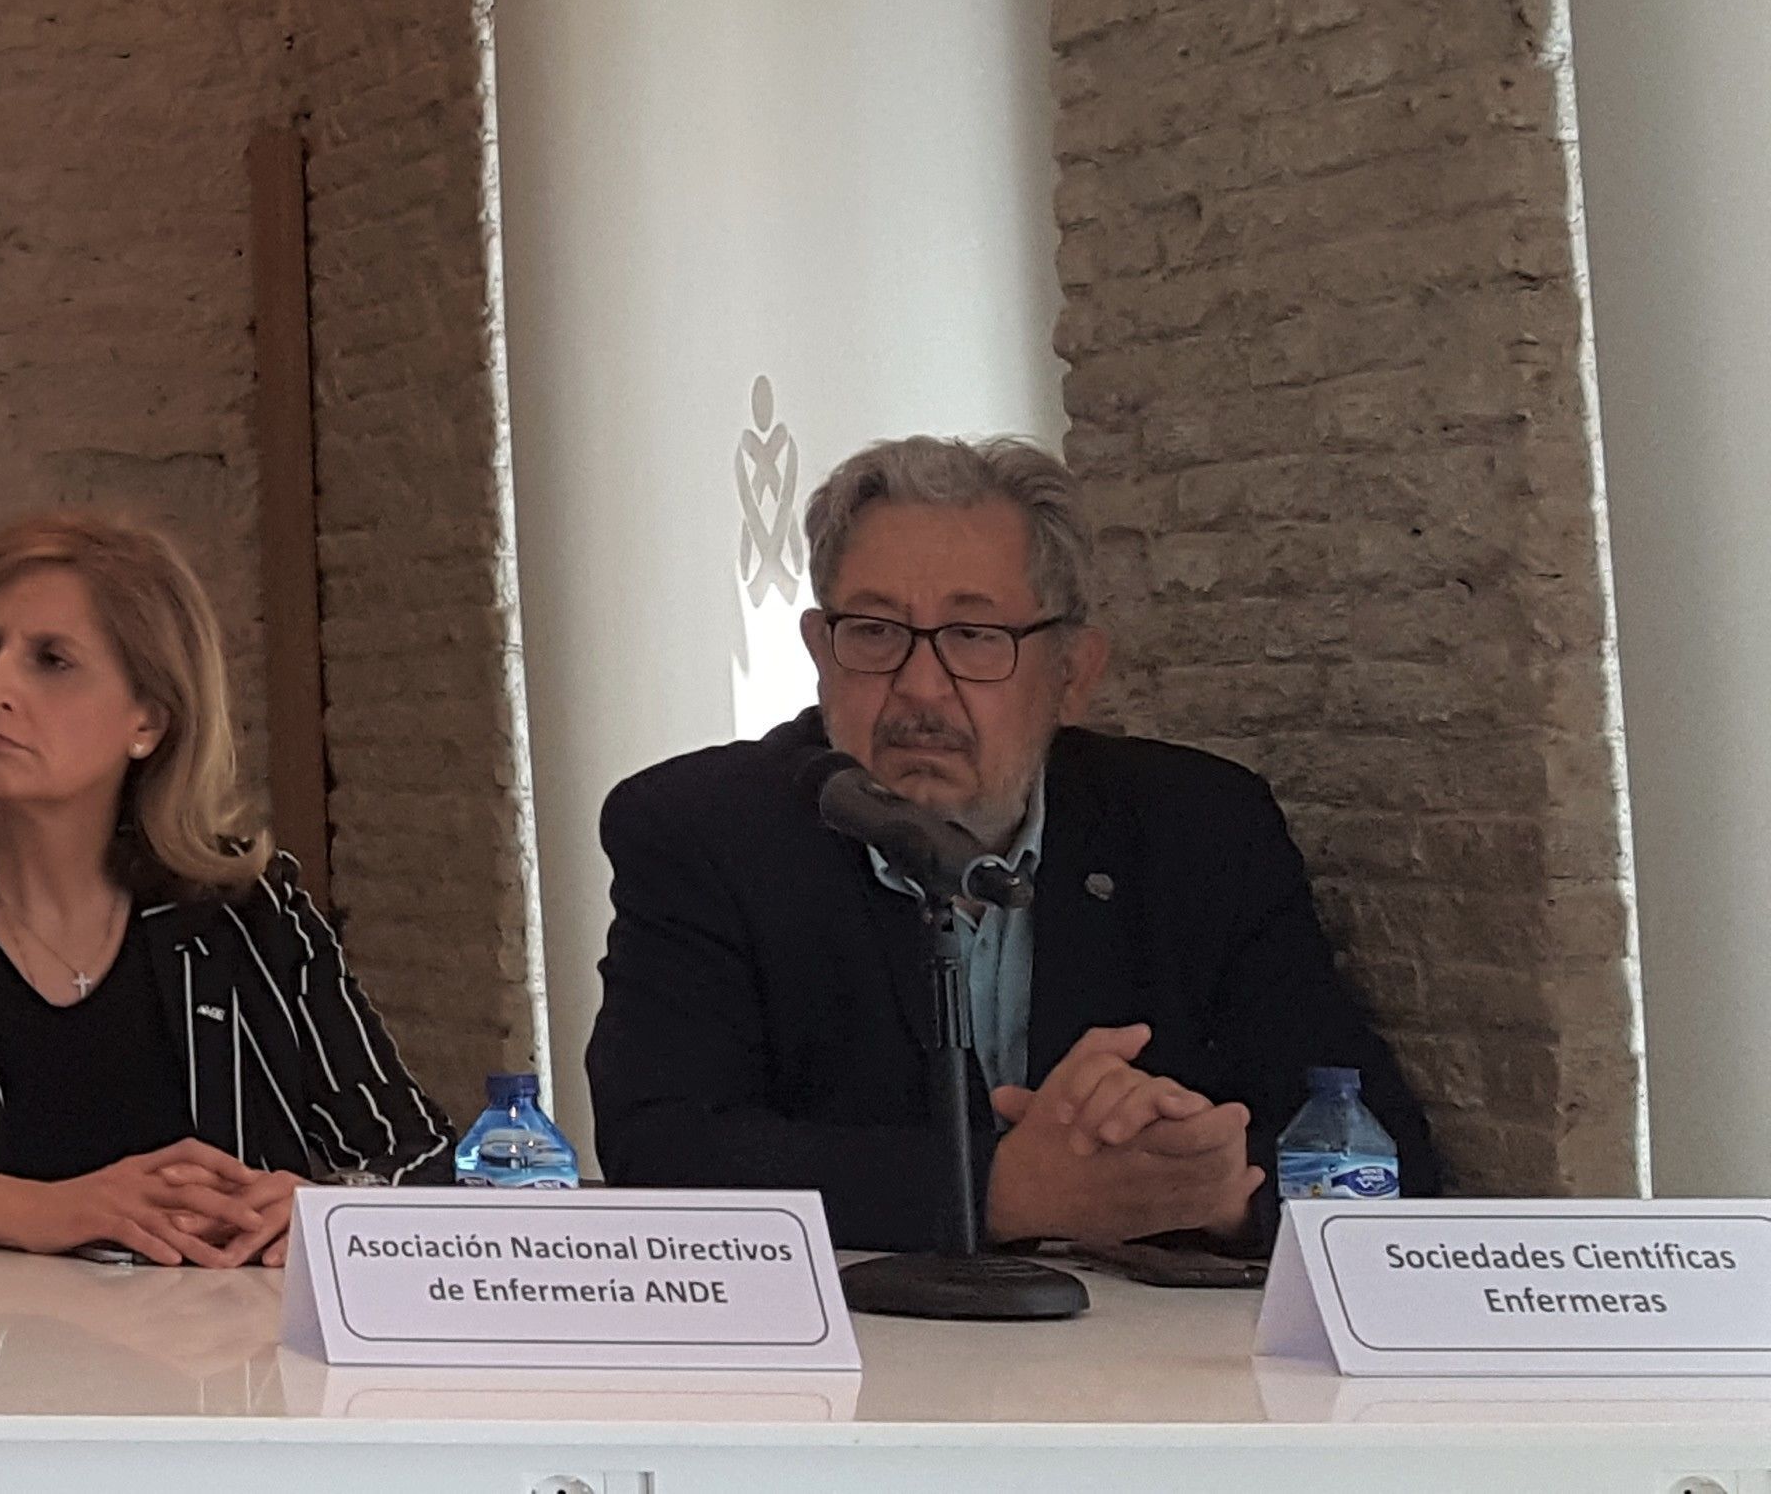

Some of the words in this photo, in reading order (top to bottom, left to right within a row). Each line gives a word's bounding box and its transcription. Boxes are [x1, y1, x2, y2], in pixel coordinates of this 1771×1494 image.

[346, 1232, 503, 1260] Asociación
[510, 1234, 639, 1261] Nacional
[645, 1235, 794, 1263] Directivos
[1384, 1241, 1566, 1271] Sociedades
[1571, 1240, 1737, 1271] Científicas
[428, 1276, 465, 1302] de
[472, 1277, 636, 1304] Enfermería
[643, 1279, 730, 1305] ANDE
[1482, 1285, 1669, 1314] Enfermeras
